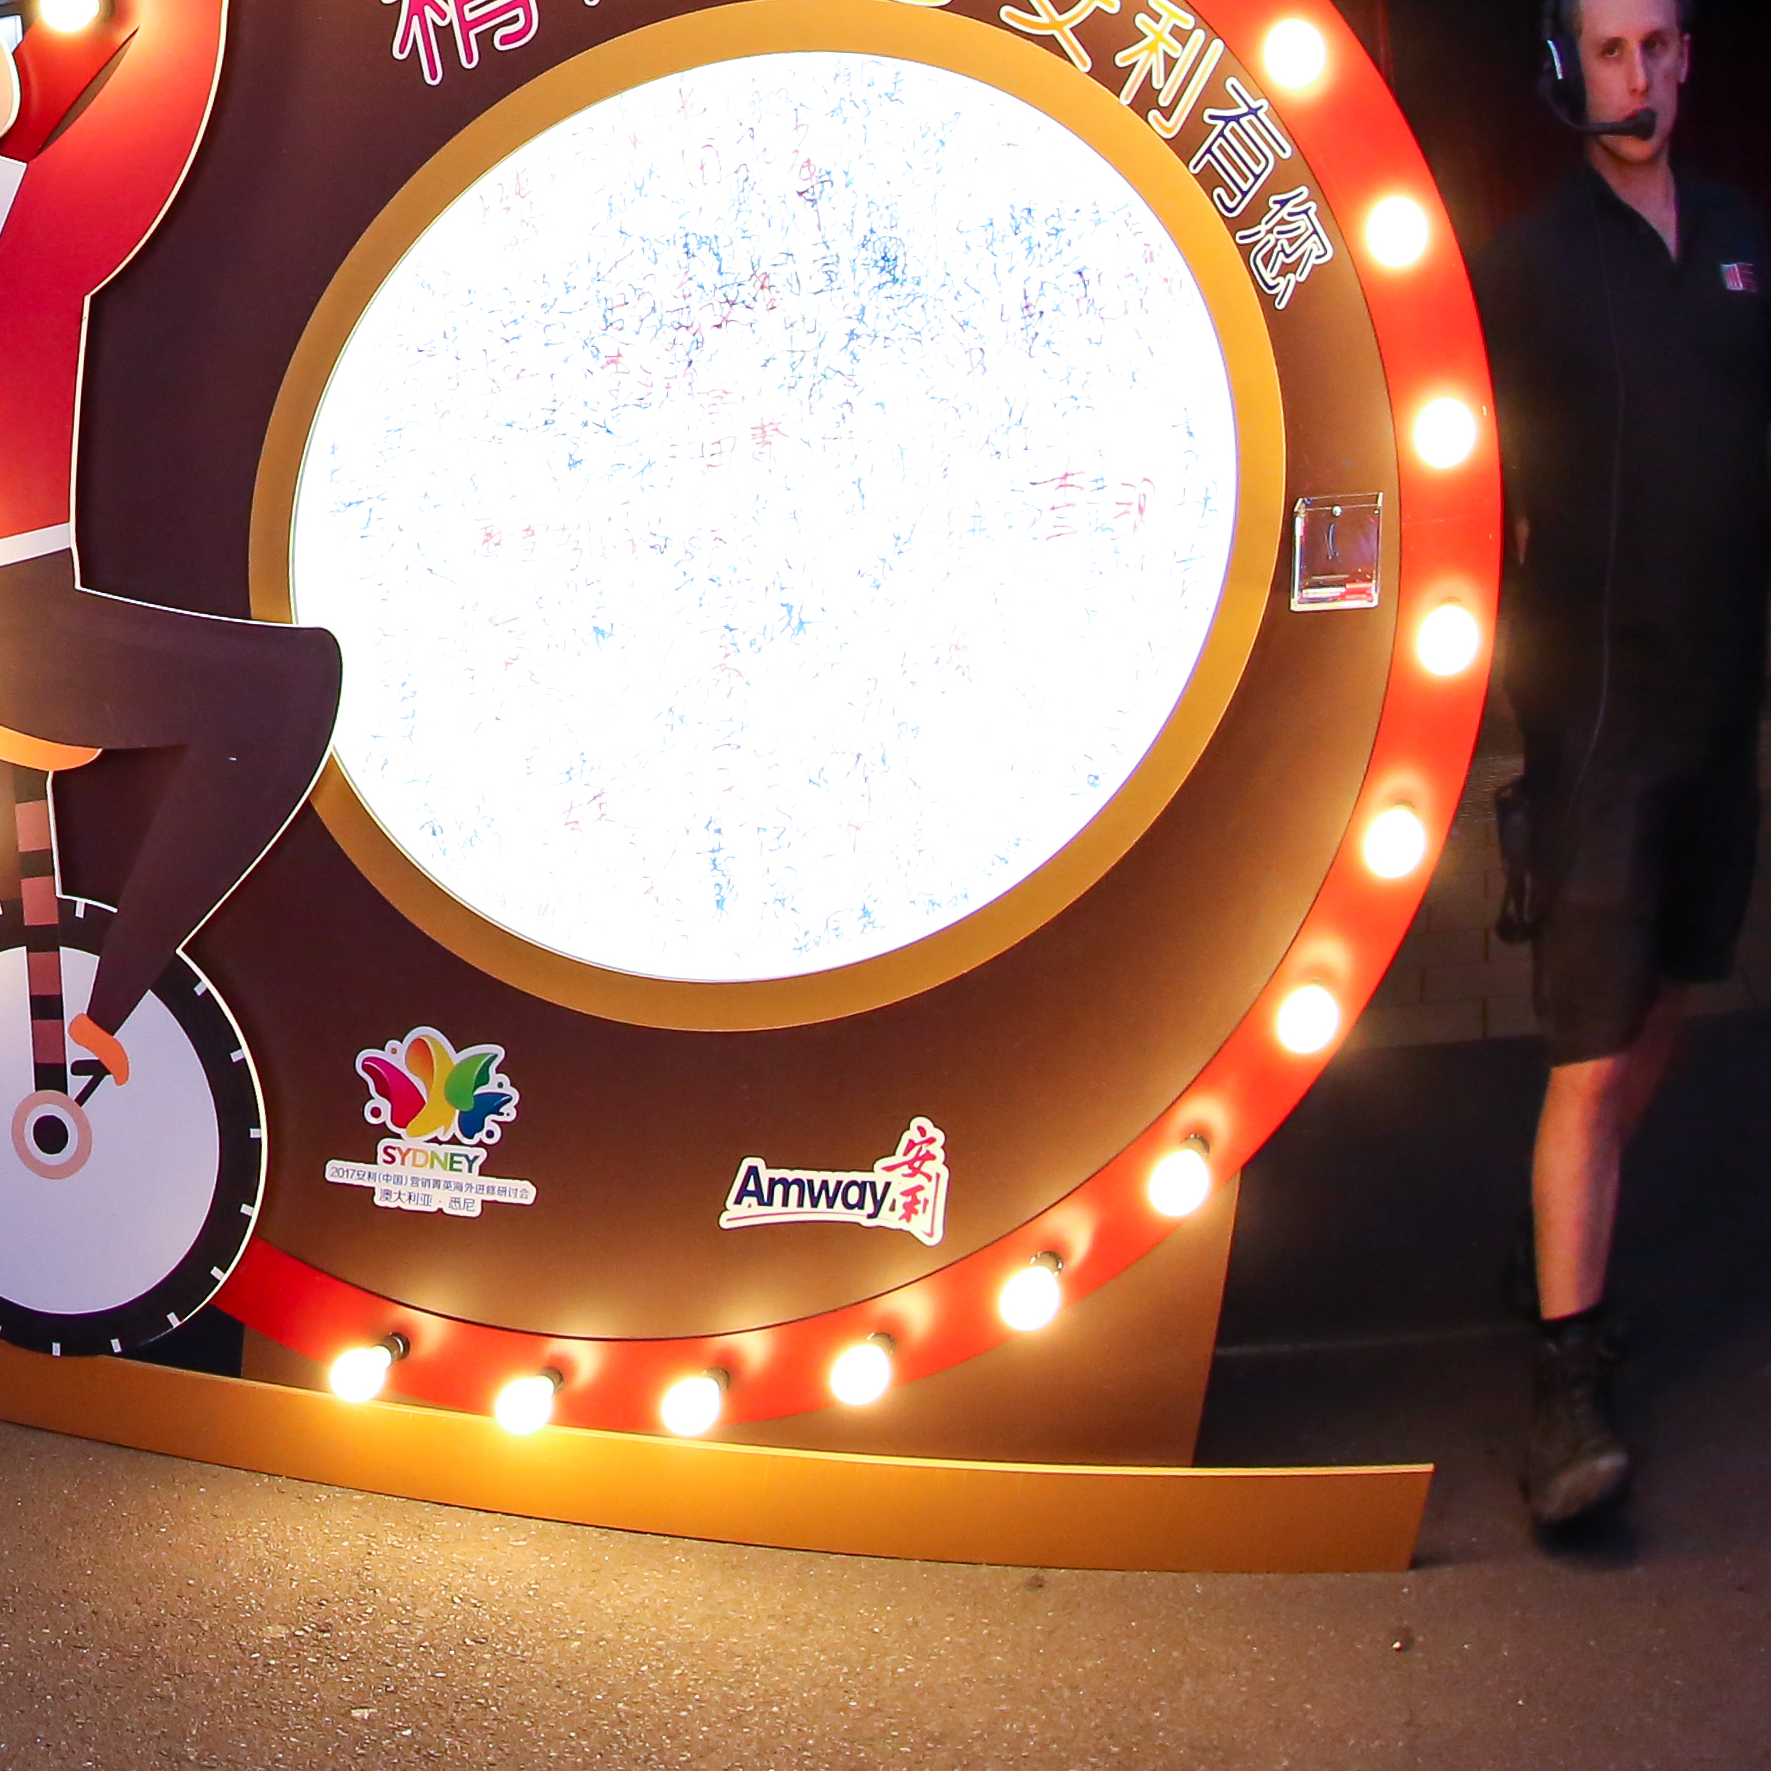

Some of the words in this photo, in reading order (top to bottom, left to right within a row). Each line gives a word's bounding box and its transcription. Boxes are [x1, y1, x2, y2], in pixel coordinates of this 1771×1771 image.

[381, 1144, 481, 1174] SYDNEY
[880, 1125, 941, 1238] 安利
[733, 1164, 893, 1220] Amway
